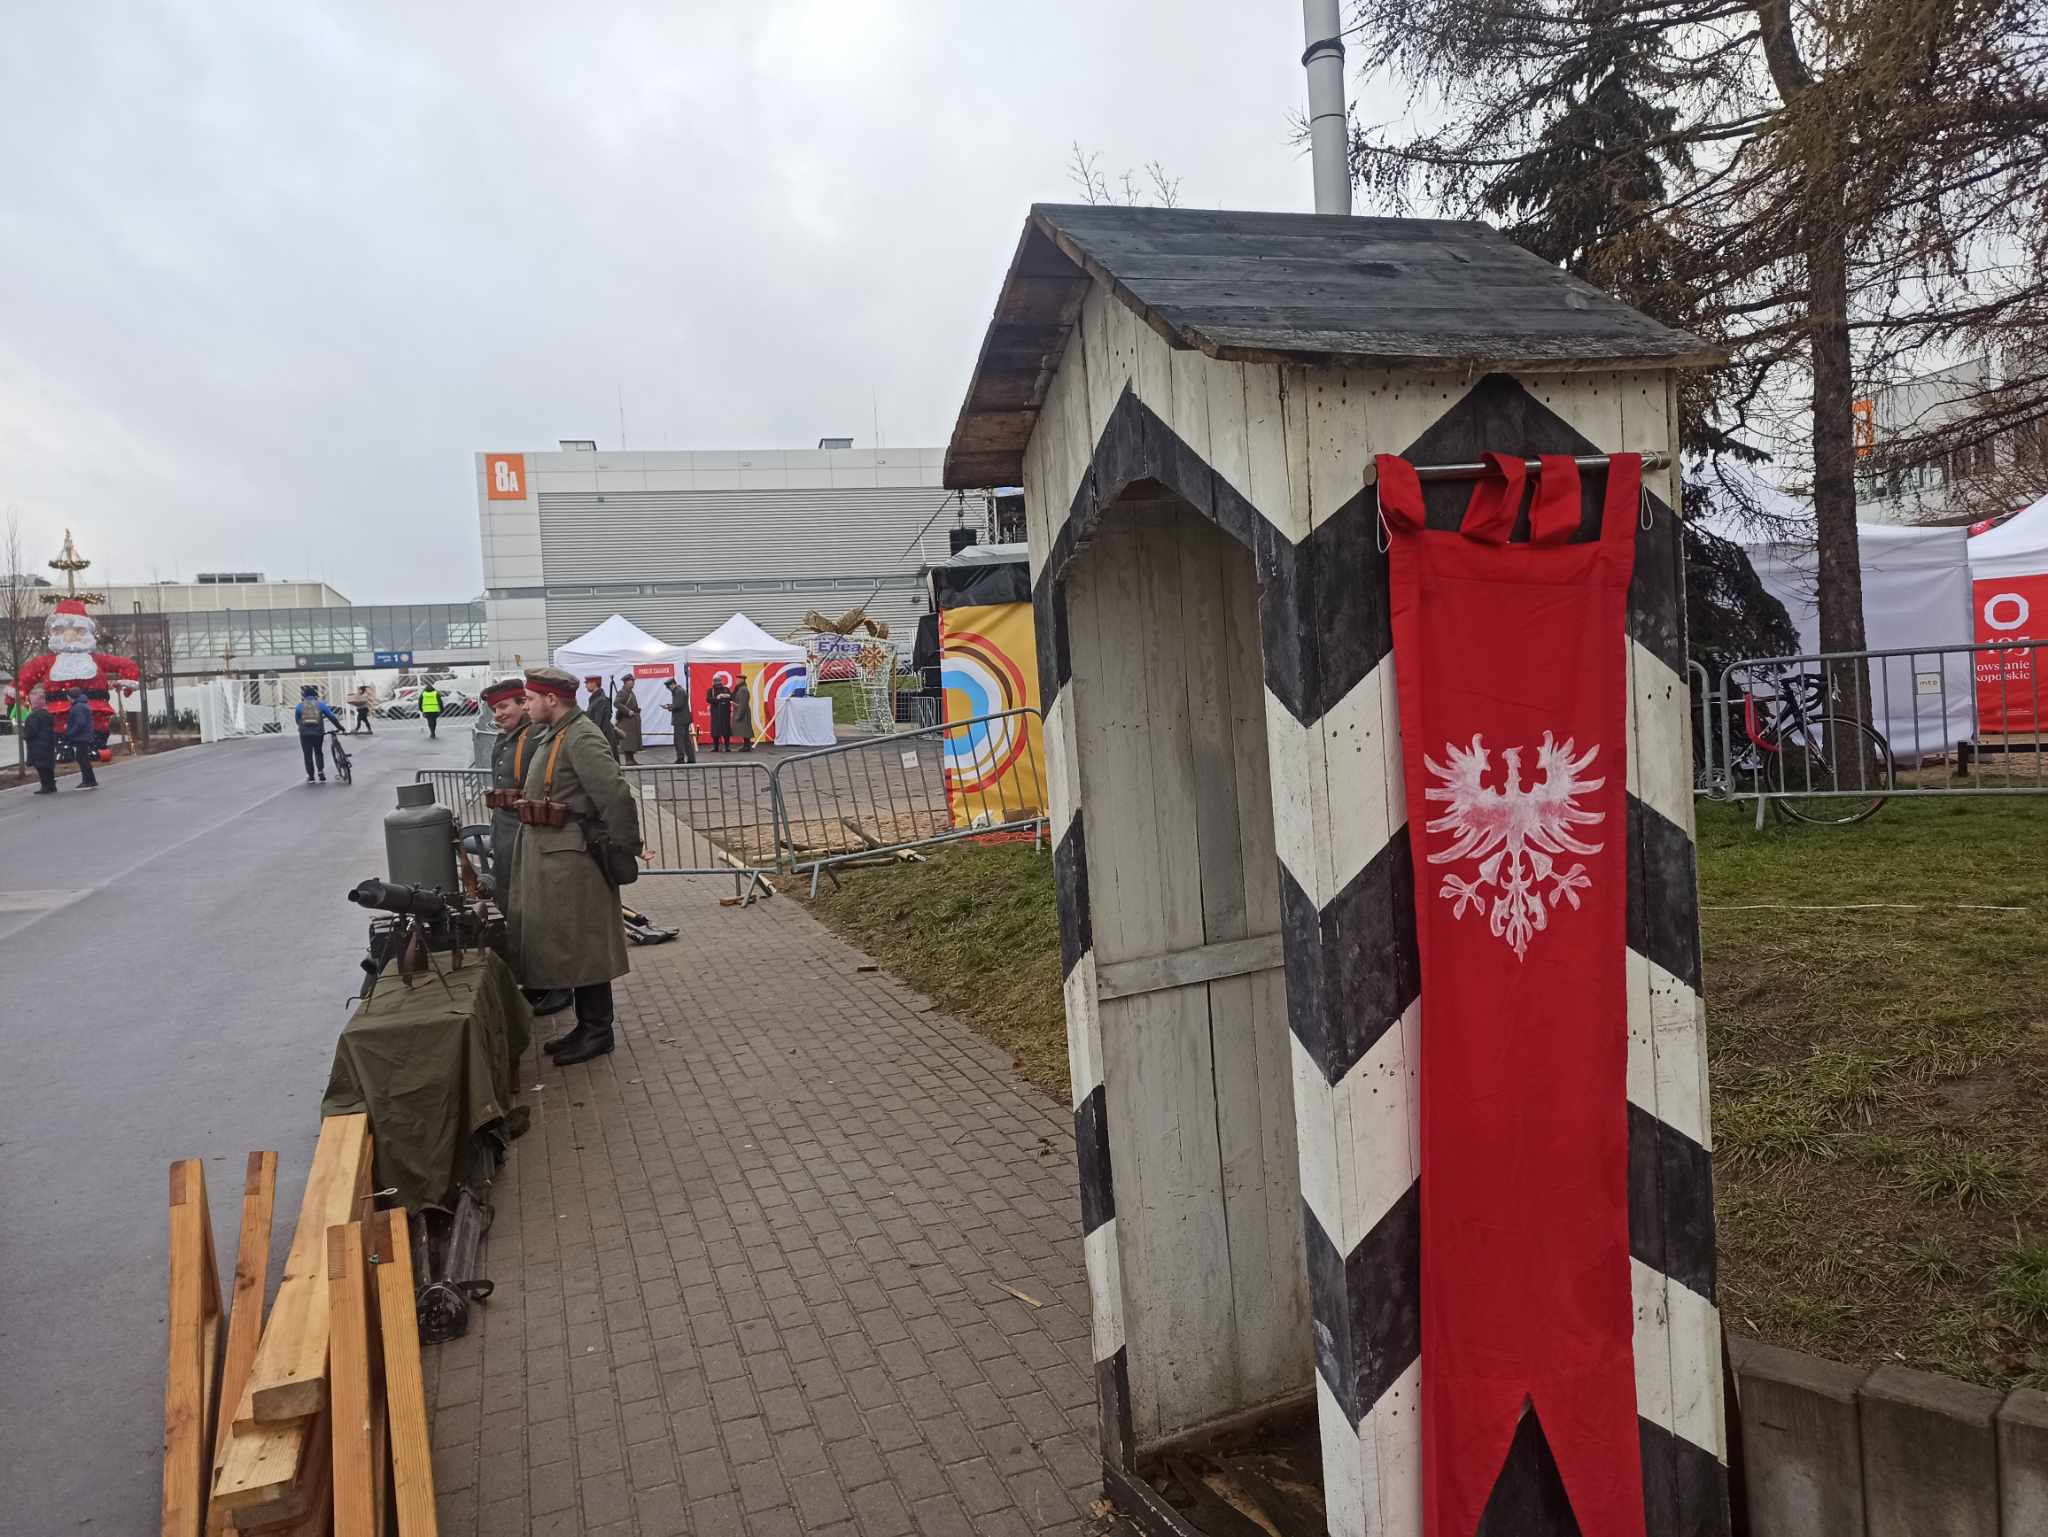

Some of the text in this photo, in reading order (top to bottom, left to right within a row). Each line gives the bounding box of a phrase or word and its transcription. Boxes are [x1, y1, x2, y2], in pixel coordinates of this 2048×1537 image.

[495, 461, 519, 491] 8A
[1976, 660, 2030, 672] owsanie
[1976, 670, 2030, 683] oposkie
